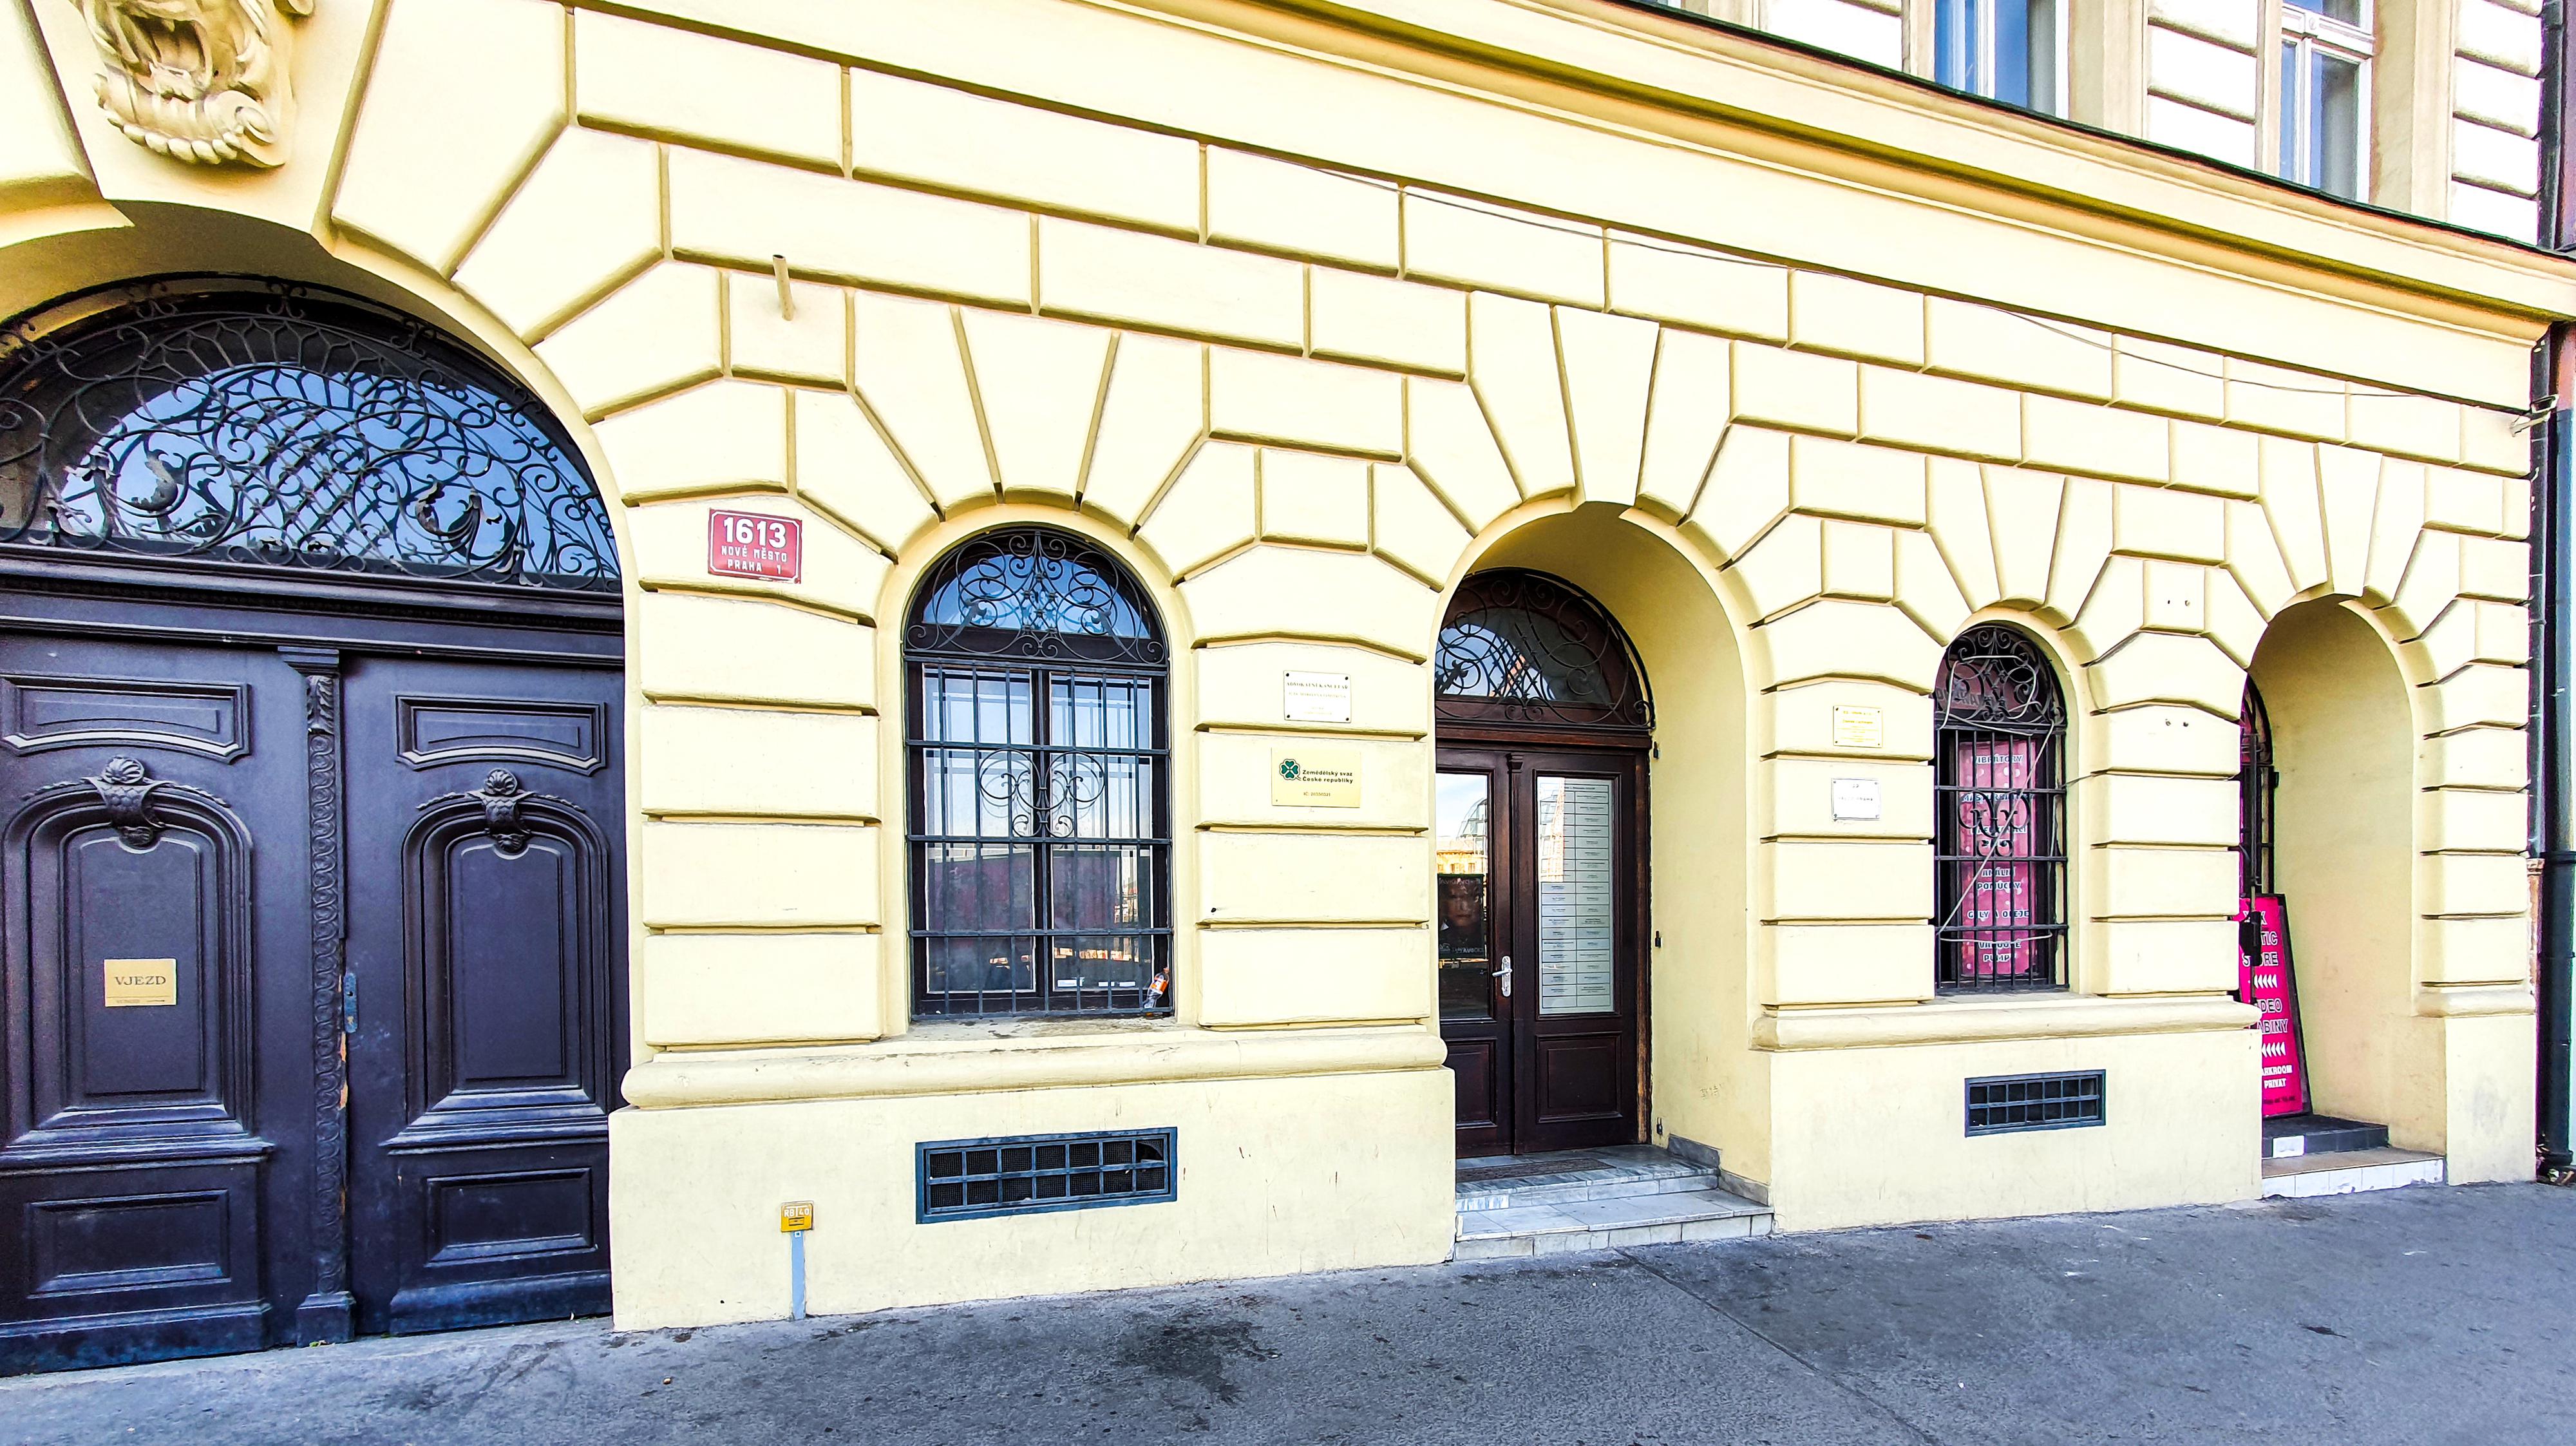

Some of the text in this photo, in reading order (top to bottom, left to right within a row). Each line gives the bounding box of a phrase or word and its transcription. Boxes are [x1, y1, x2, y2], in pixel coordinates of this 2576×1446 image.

[723, 517, 786, 548] 1613
[721, 545, 787, 562] NOVÉ MĚSTO
[727, 558, 782, 575] PRAHA 1
[115, 976, 166, 985] VJEZD
[2257, 1019, 2288, 1034] ABINY
[2262, 1065, 2293, 1076] ARKROOM
[2264, 1078, 2286, 1089] PRIVAT
